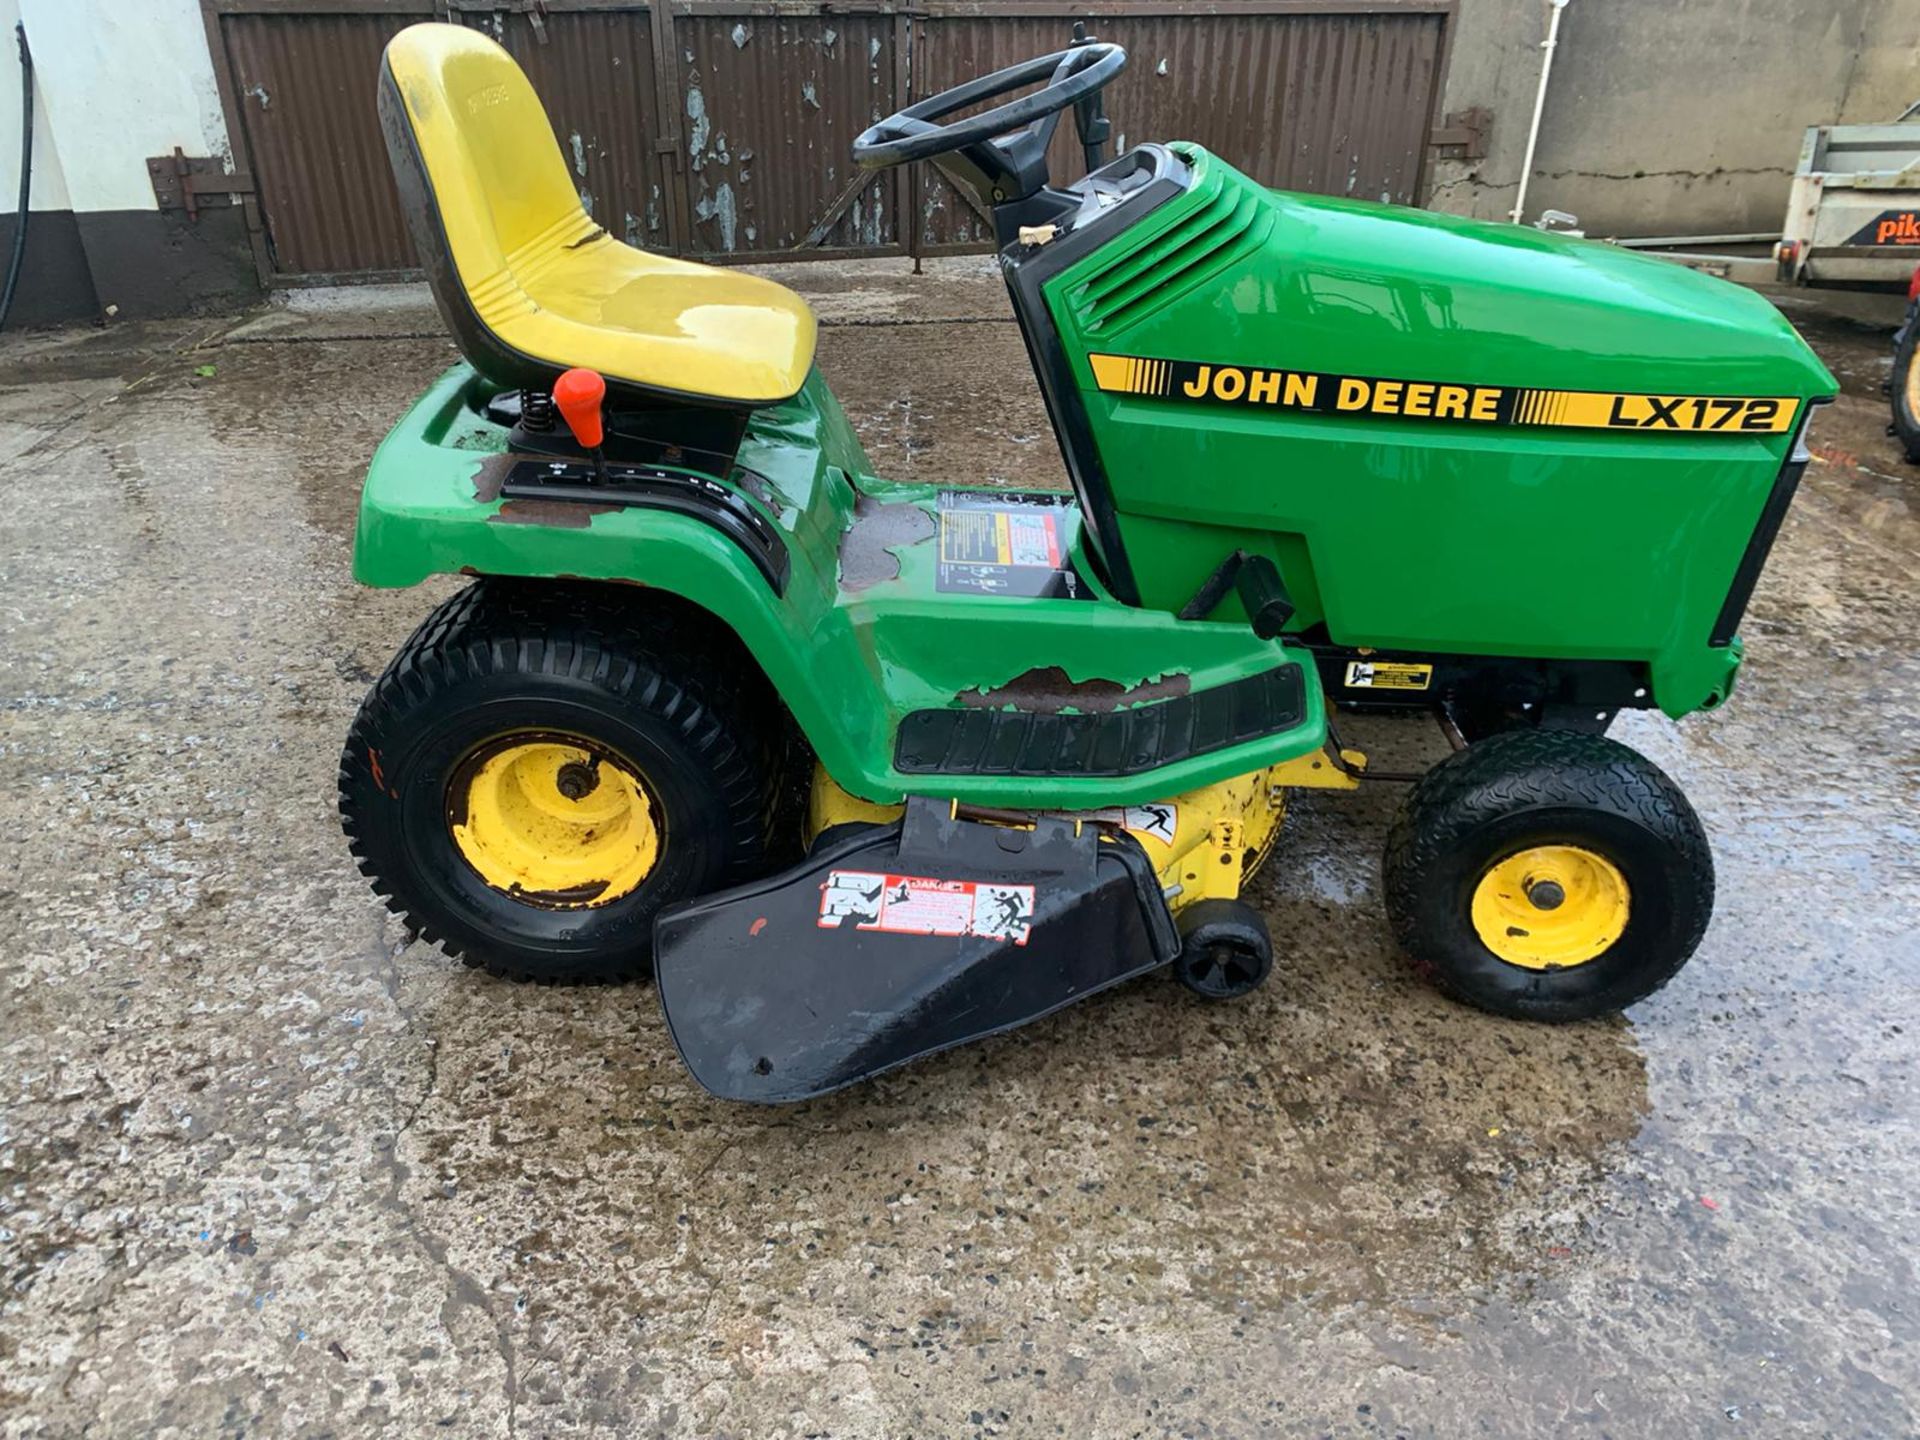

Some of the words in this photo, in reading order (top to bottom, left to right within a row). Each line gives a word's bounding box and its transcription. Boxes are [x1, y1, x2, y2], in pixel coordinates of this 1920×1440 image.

[1183, 366, 1318, 407] JOHN
[1336, 378, 1502, 421] DEERE
[1608, 396, 1779, 430] LX172
